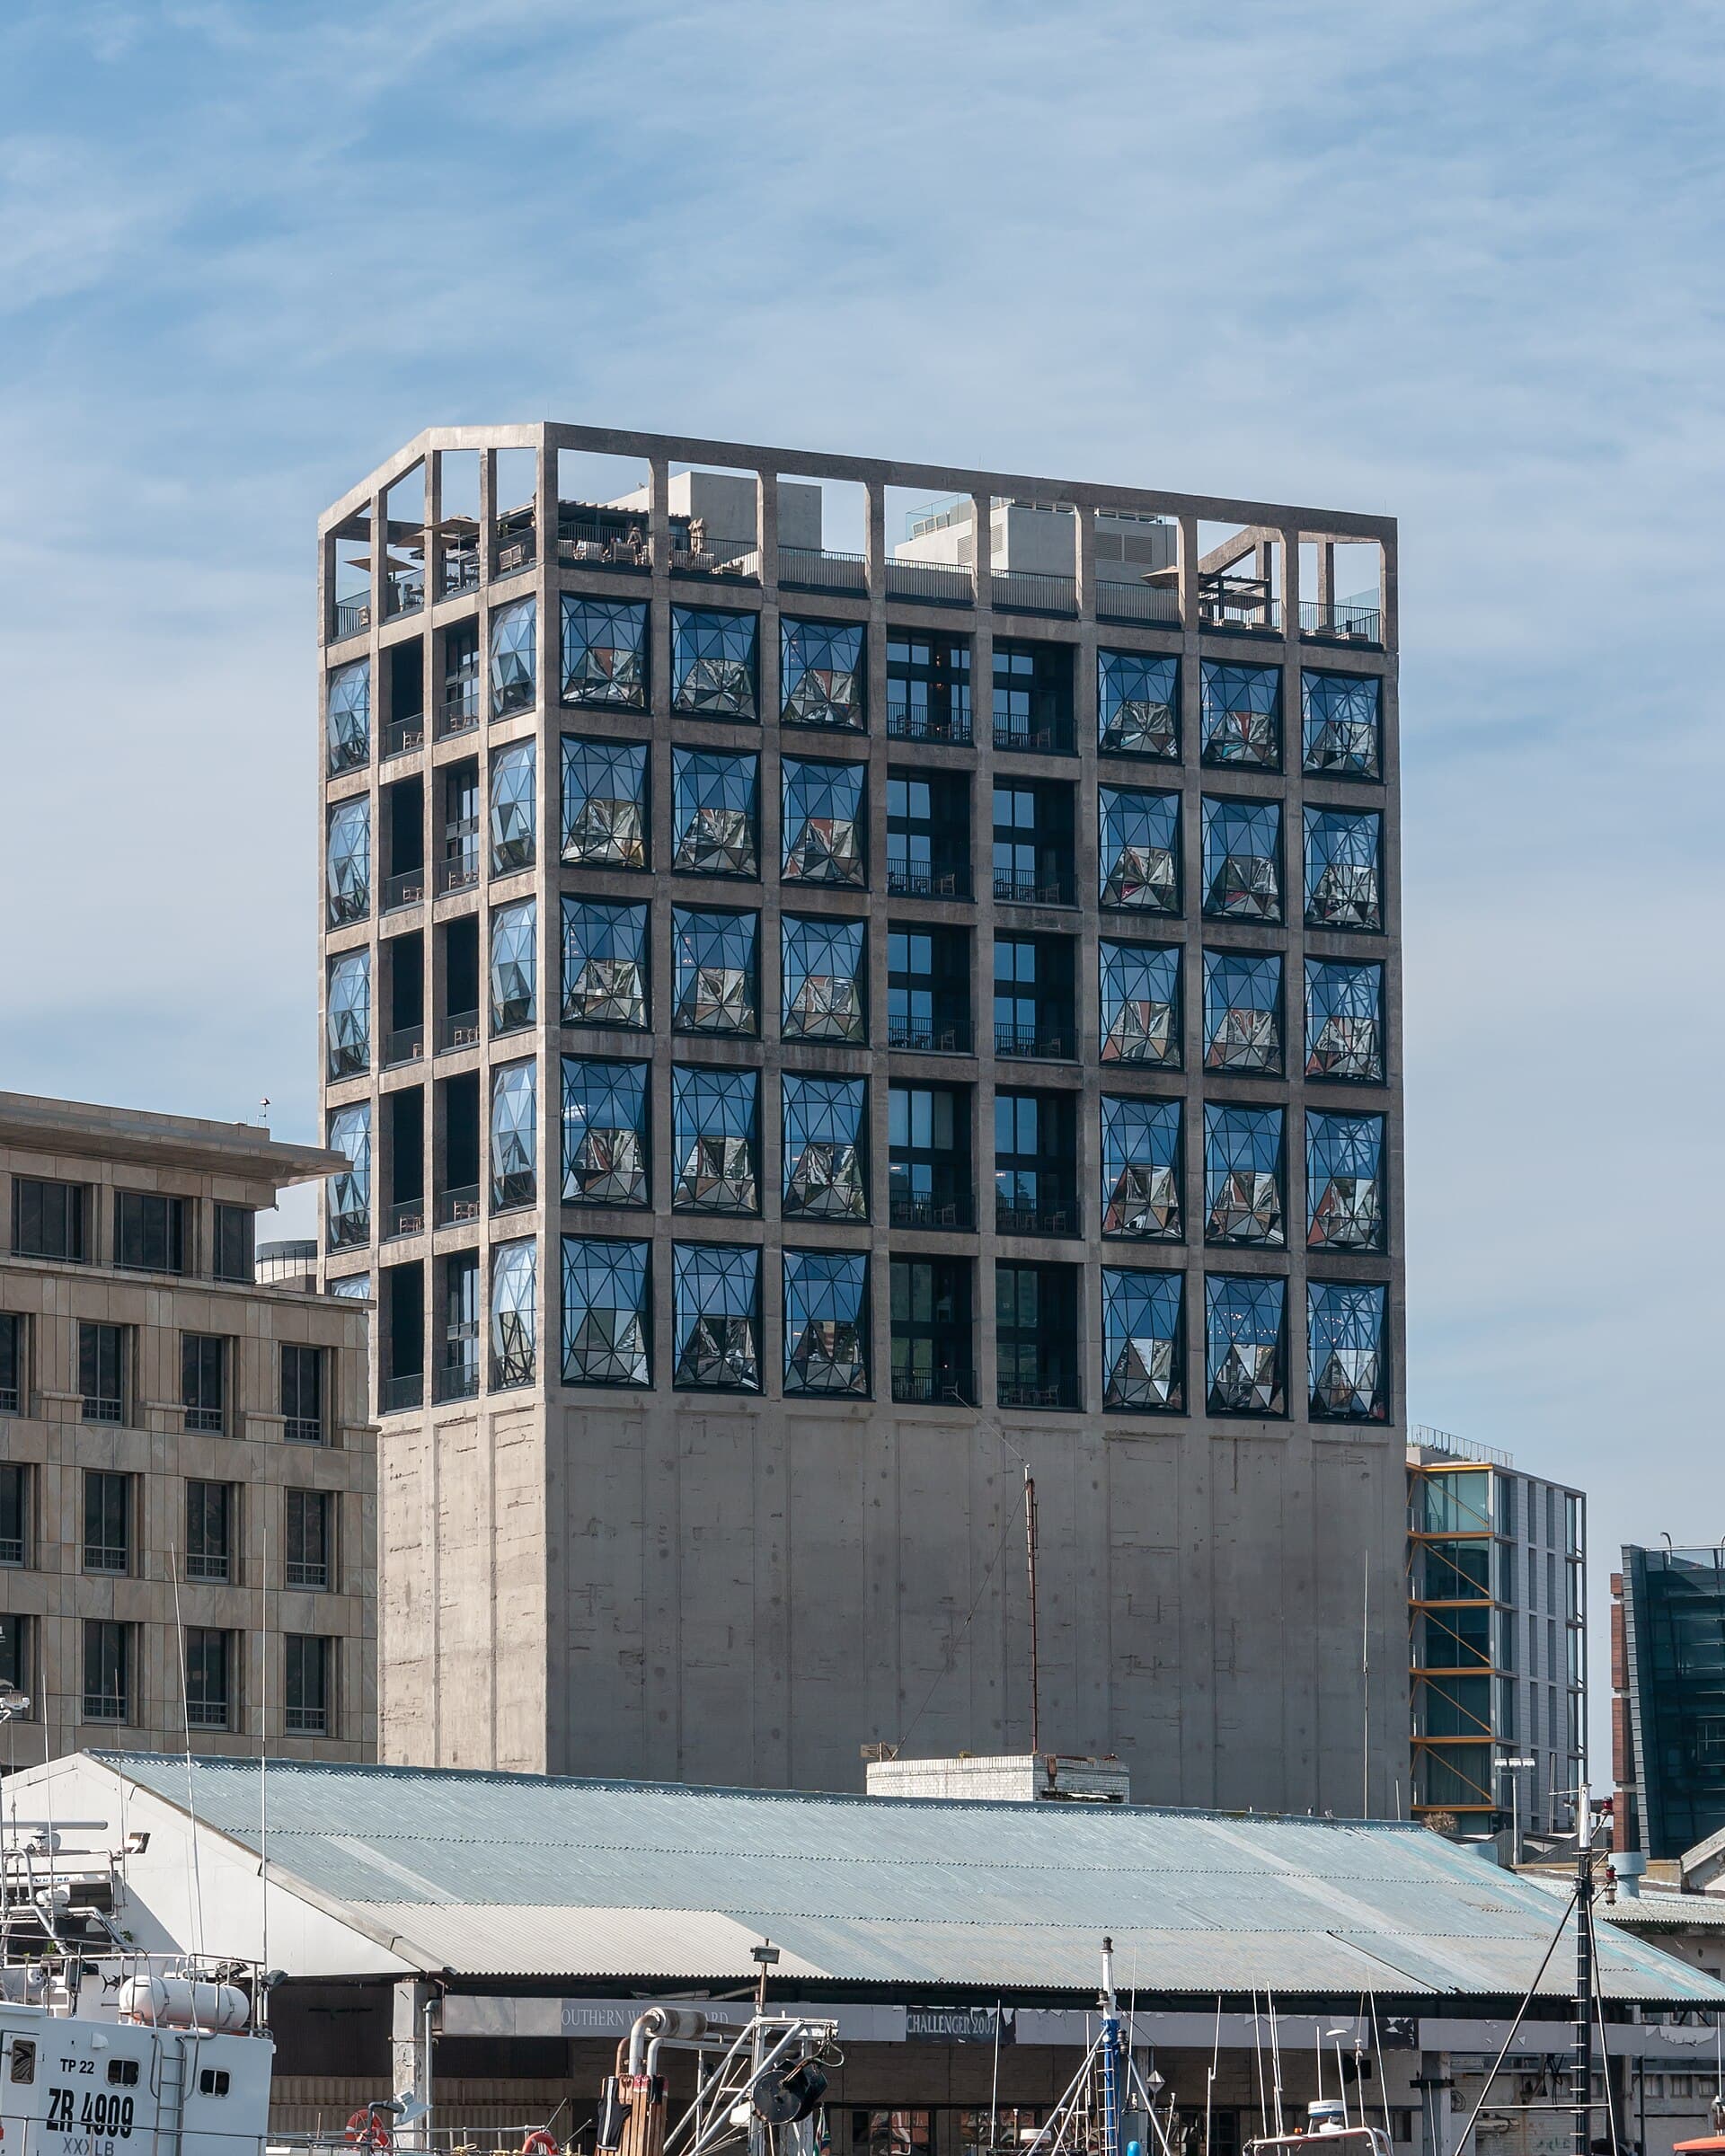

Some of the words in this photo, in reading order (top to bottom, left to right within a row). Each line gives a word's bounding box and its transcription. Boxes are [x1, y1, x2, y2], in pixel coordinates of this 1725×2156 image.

[907, 2014, 970, 2034] CHALLENGER
[60, 2058, 75, 2072] TP
[79, 2060, 94, 2074] 22
[47, 2088, 74, 2133] ZR
[80, 2092, 134, 2139] 4909
